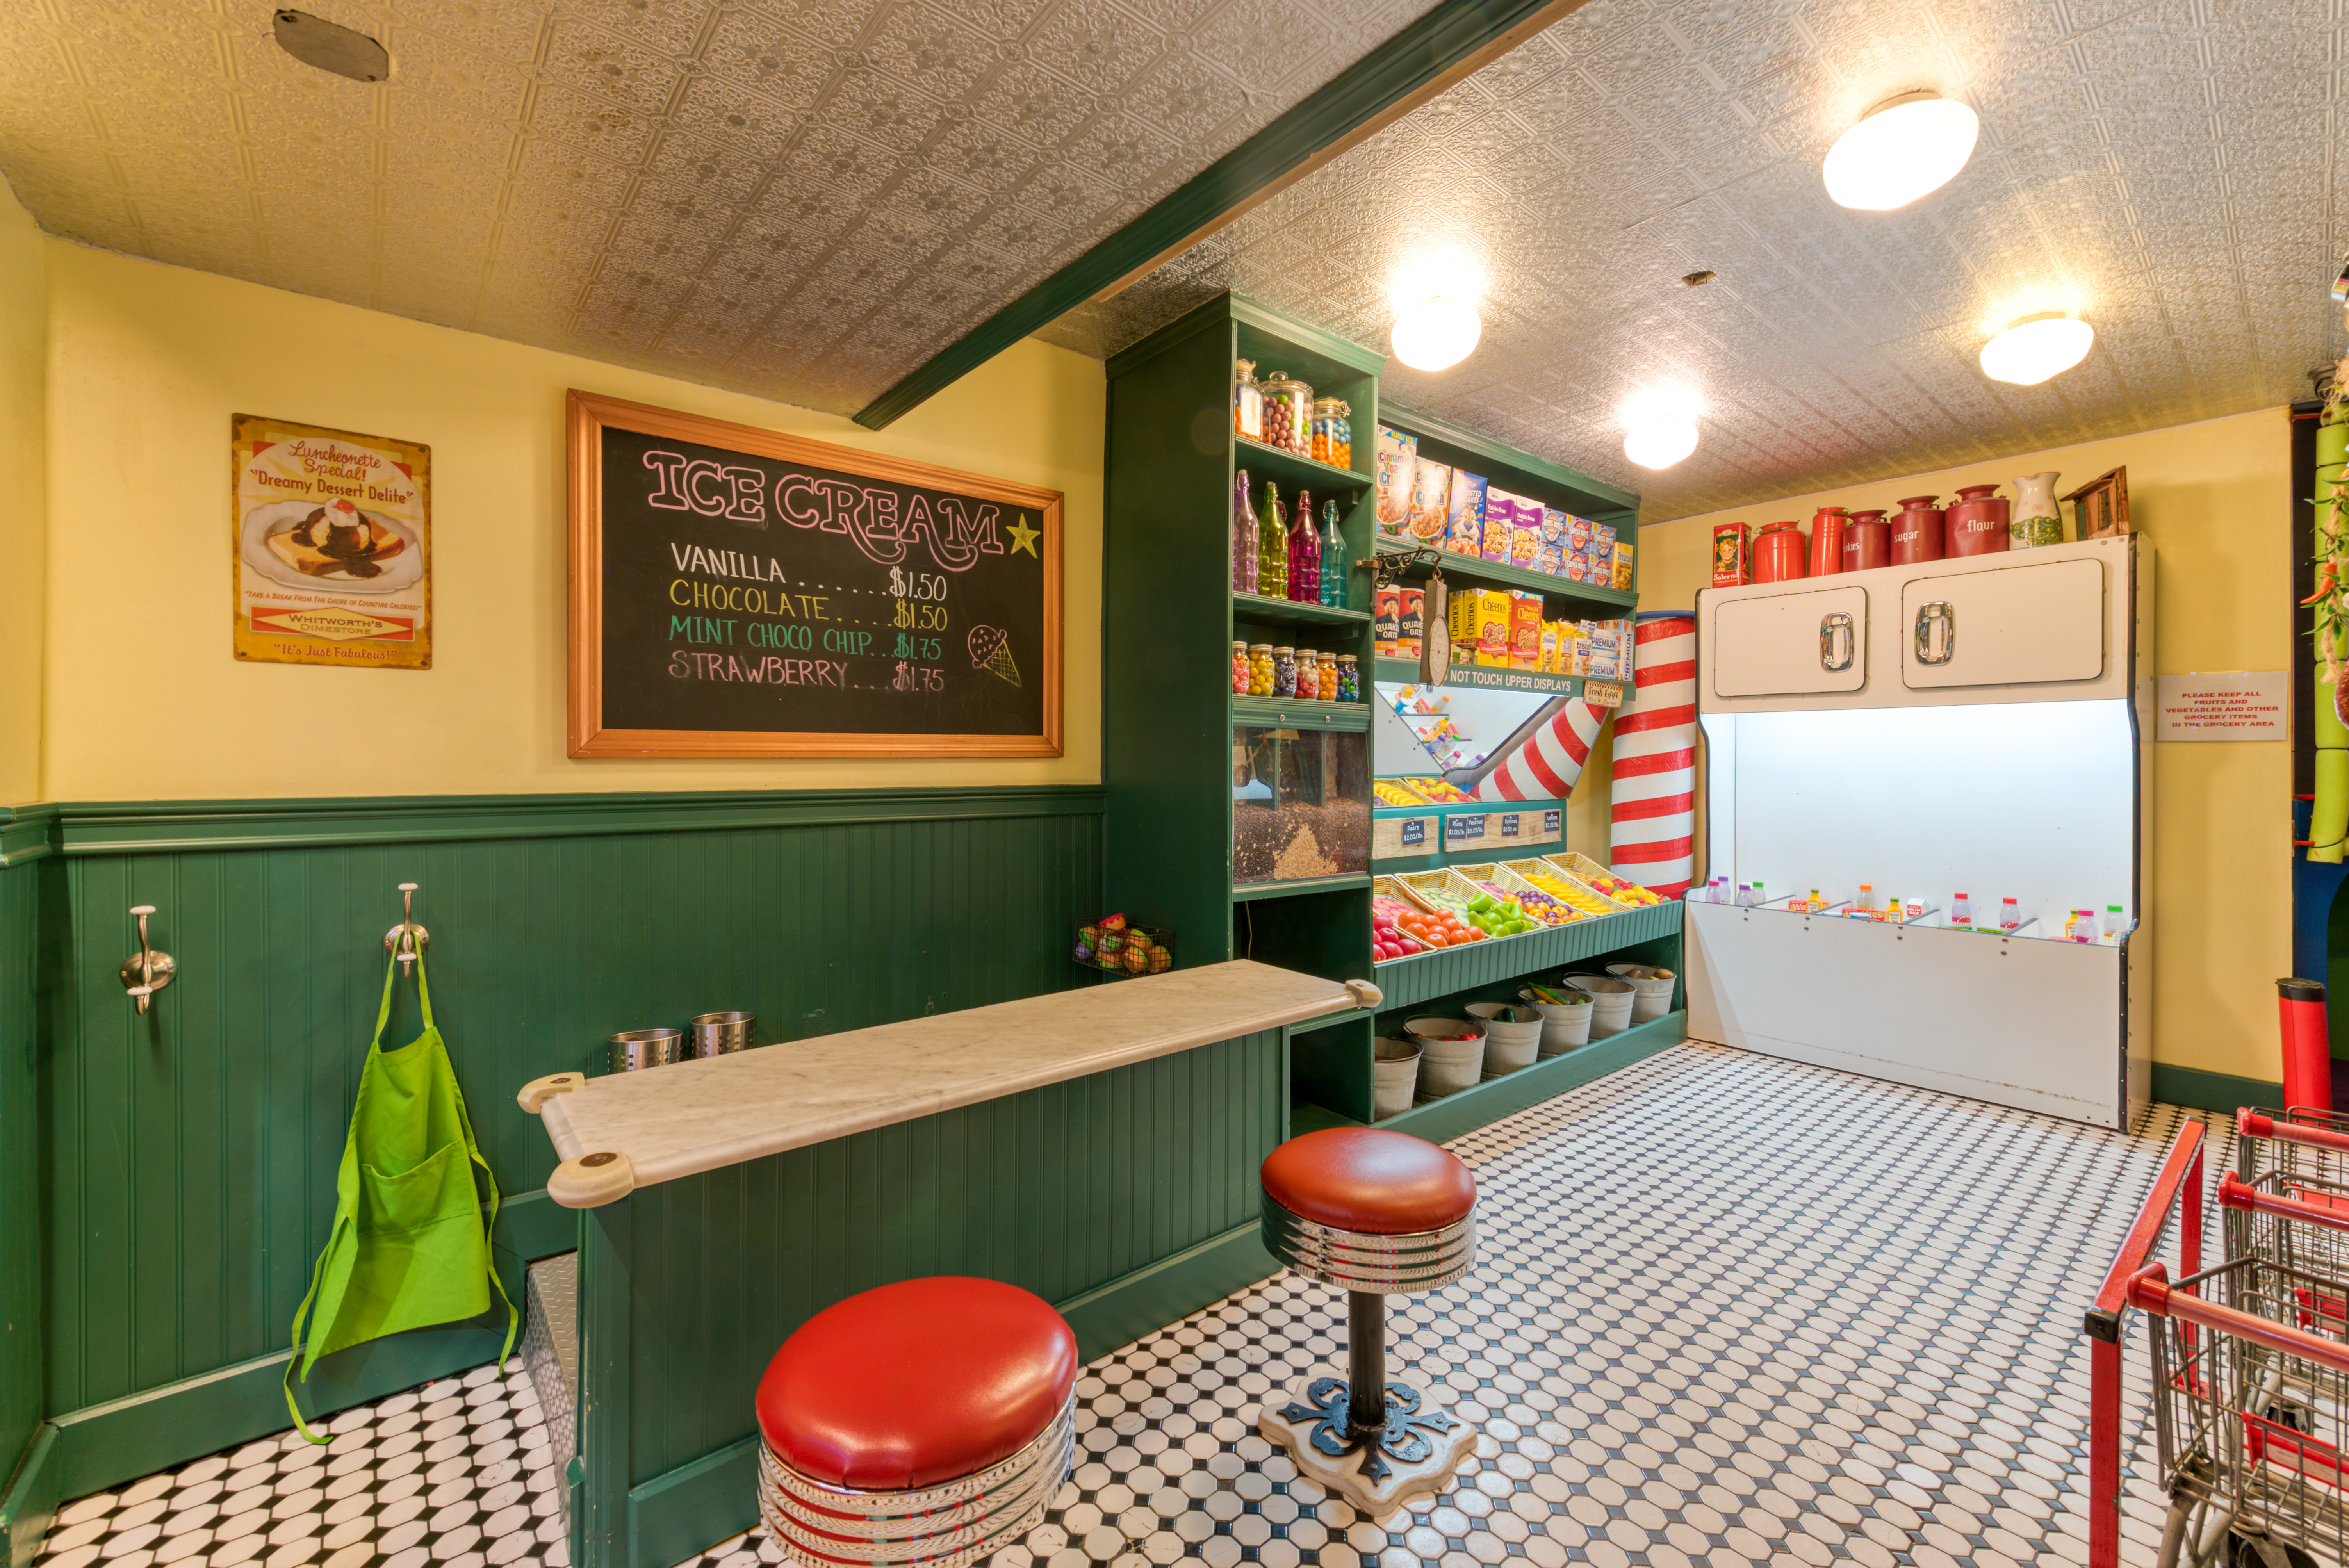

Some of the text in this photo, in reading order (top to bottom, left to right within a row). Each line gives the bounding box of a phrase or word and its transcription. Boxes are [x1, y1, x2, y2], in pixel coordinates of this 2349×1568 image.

[1391, 431, 1405, 441] FAMILY
[288, 441, 381, 468] Luncheonette
[1379, 451, 1410, 464] Cinnamon
[304, 458, 366, 482] Special!
[1381, 471, 1409, 485] Crunh
[1416, 471, 1445, 483] Cinnmon
[250, 469, 413, 504] "Dreamy Dessert Delite"
[643, 450, 1003, 571] ICE CREAM
[1967, 520, 1995, 533] flour
[1894, 530, 1919, 543] sugar
[1843, 542, 1860, 553] ookies
[671, 542, 947, 601] VANILLA $1.50
[358, 600, 388, 608] COUNTING
[670, 579, 948, 631] CHOCOLATE $1.50
[1483, 599, 1506, 614] Cheerios
[288, 614, 383, 628] WHITWORTH'S
[1466, 603, 1475, 635] Cheerios
[1518, 608, 1539, 622] Cheerios
[300, 624, 372, 635] DIMESTORE
[1402, 620, 1423, 630] QUAKE
[669, 615, 738, 645] MINT
[747, 622, 812, 650] CHOCO
[894, 632, 941, 660] $1.75
[1383, 631, 1397, 639] OATS
[1542, 636, 1556, 645] Bisquick
[1592, 637, 1616, 649] PREMIUM
[305, 645, 330, 657] Just
[334, 647, 397, 659] Fabulous!"
[669, 650, 944, 691] STRAWBERRY $1.75
[1590, 665, 1615, 675] PREMIUM
[1450, 670, 1470, 683] NOT
[1472, 672, 1502, 686] TOUCH
[1505, 675, 1532, 689] UPPER
[1534, 678, 1571, 692] DISPLAYS
[1605, 689, 1618, 700] Eggs
[1404, 832, 1423, 841] $2.00/lb.
